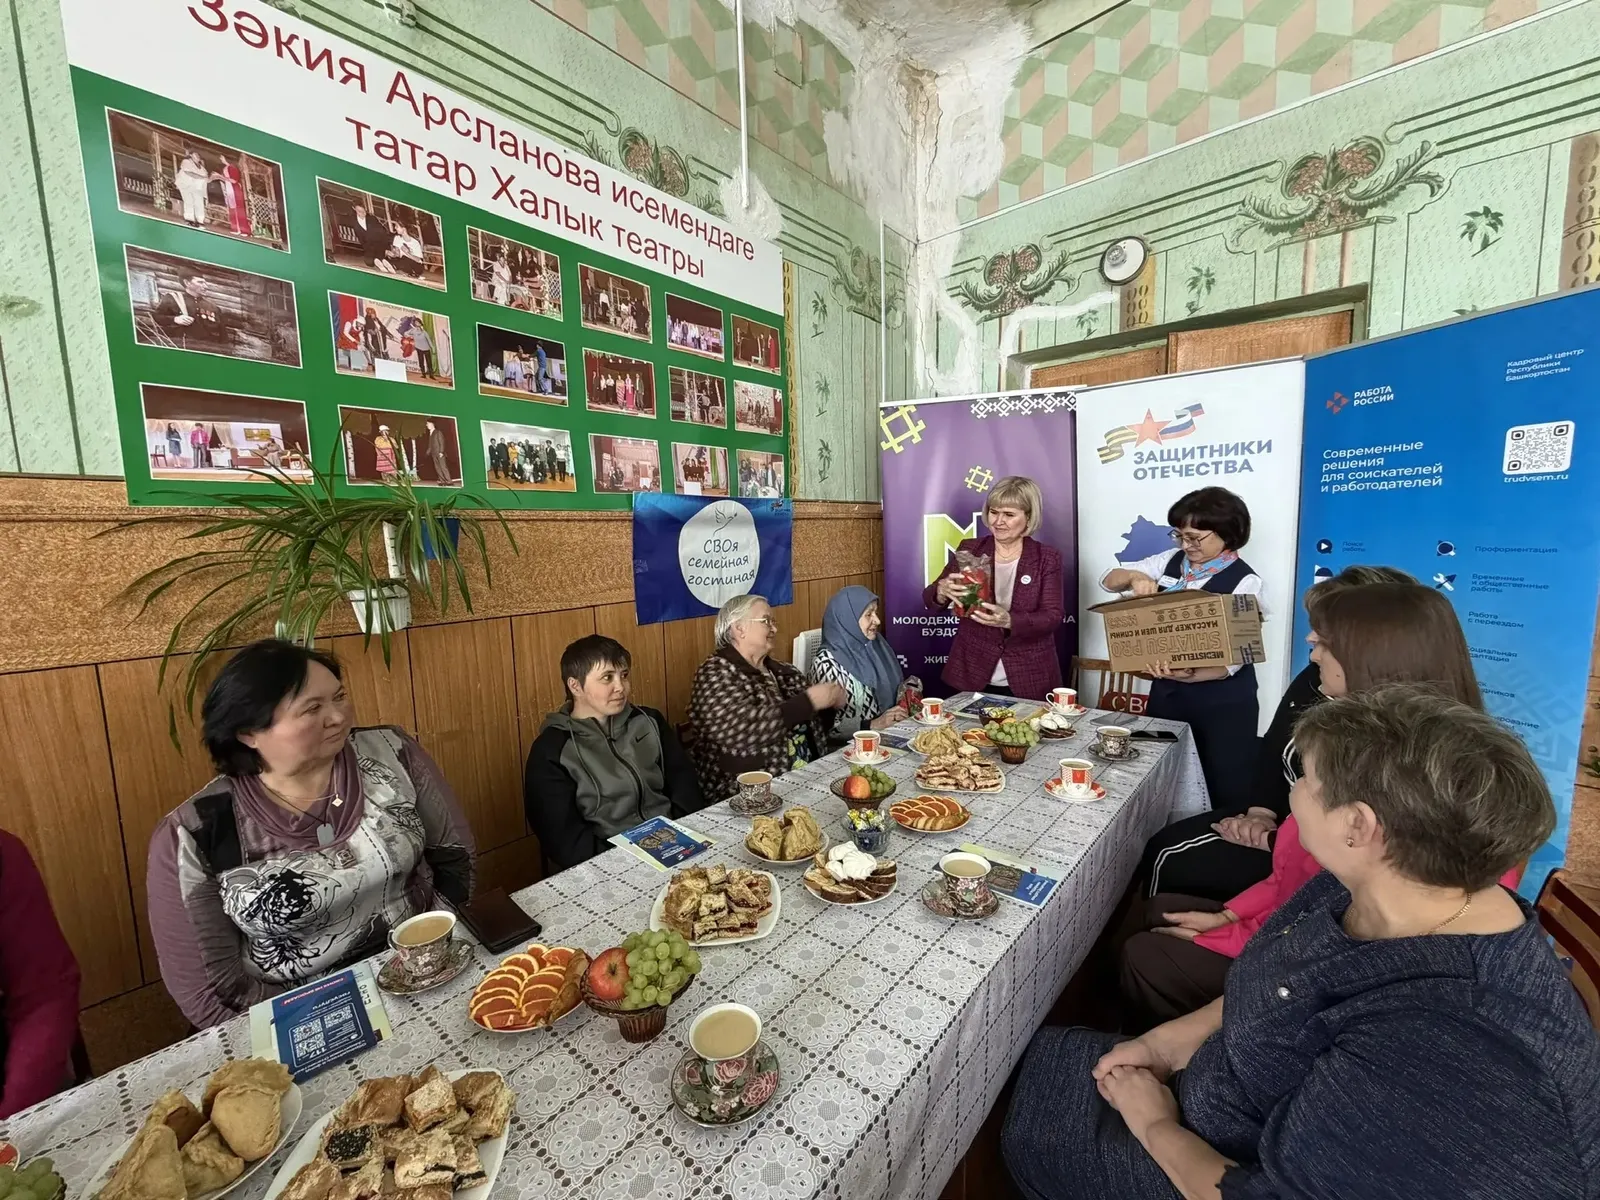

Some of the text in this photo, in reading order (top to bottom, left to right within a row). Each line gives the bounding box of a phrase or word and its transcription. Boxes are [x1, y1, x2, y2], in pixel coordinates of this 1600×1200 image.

[189, 0, 755, 261] Зәкия Арсланова исемендаге
[345, 117, 705, 278] татар Халык театры
[1507, 348, 1585, 368] Кадровый центр
[1505, 367, 1571, 382] Башкортостан
[1506, 361, 1561, 374] Республики
[1354, 385, 1392, 399] РАБОТА
[1353, 393, 1394, 407] РОССИИ
[1133, 439, 1272, 465] ЗАЩИТНИКИ
[1323, 441, 1424, 459] Современные
[1133, 458, 1254, 481] ОТЕЧЕСТВА
[1322, 457, 1384, 472] решения
[1320, 462, 1443, 483] для соискателей
[1503, 474, 1569, 483] trudvsem.ru
[1320, 475, 1443, 494] и работодателей
[703, 538, 739, 554] СВОя
[1474, 545, 1558, 554] Профориентация
[687, 554, 749, 569] семейная
[687, 569, 755, 586] гостиная
[1472, 573, 1525, 582] Временные
[1479, 580, 1549, 590] общественные
[1468, 610, 1499, 620] Работа
[1158, 624, 1174, 634] ДЛЯ
[1175, 620, 1219, 632] МАССАЖЕР
[1474, 618, 1524, 628] переездом
[1109, 630, 1134, 640] СПИНЫ
[1134, 629, 1140, 637] И
[1141, 627, 1157, 636] ШЕИ
[1111, 639, 1143, 658] PRO
[1146, 631, 1221, 655] SHIATSU
[1171, 650, 1225, 662] MEDISTELLAR
[1467, 646, 1518, 658] оциальная
